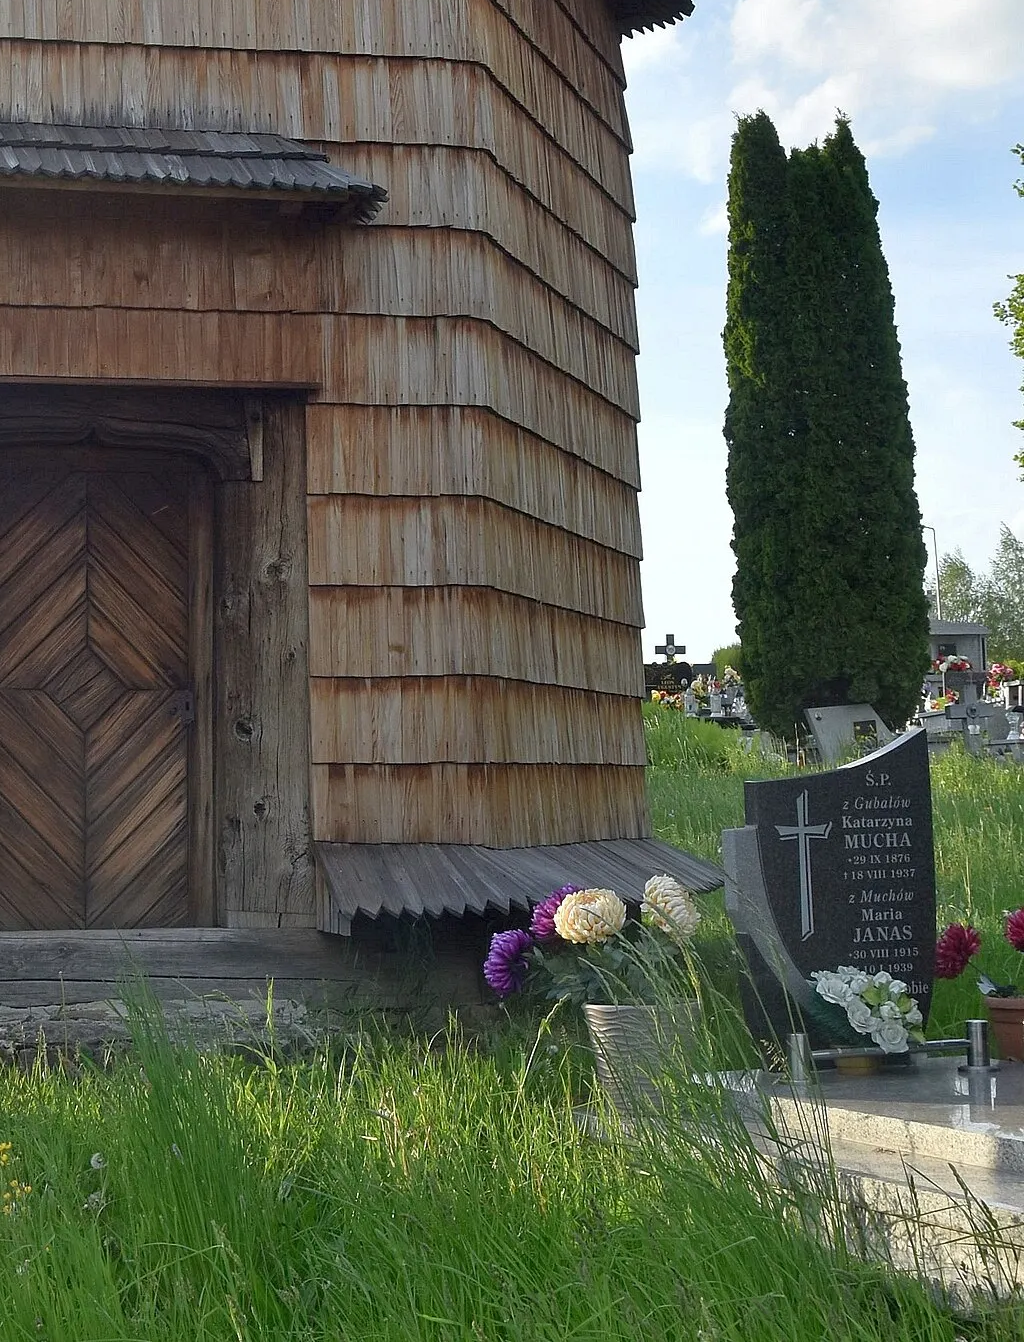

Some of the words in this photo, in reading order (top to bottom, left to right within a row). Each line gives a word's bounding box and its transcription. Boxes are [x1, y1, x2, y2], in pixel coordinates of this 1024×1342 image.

[865, 770, 891, 786] Ś.P.
[842, 801, 849, 810] z
[841, 816, 913, 829] Katarzyna
[844, 832, 912, 849] MUCHA
[870, 854, 881, 864] IX
[885, 853, 911, 863] 1876
[867, 869, 886, 879] VIII
[891, 868, 916, 878] 1937
[848, 894, 855, 904] z
[860, 888, 914, 903] Muchów
[861, 908, 903, 921] Maria
[853, 925, 913, 943] JANAS
[869, 948, 889, 958] VIII
[894, 947, 919, 957] 1915
[888, 962, 913, 973] 1939
